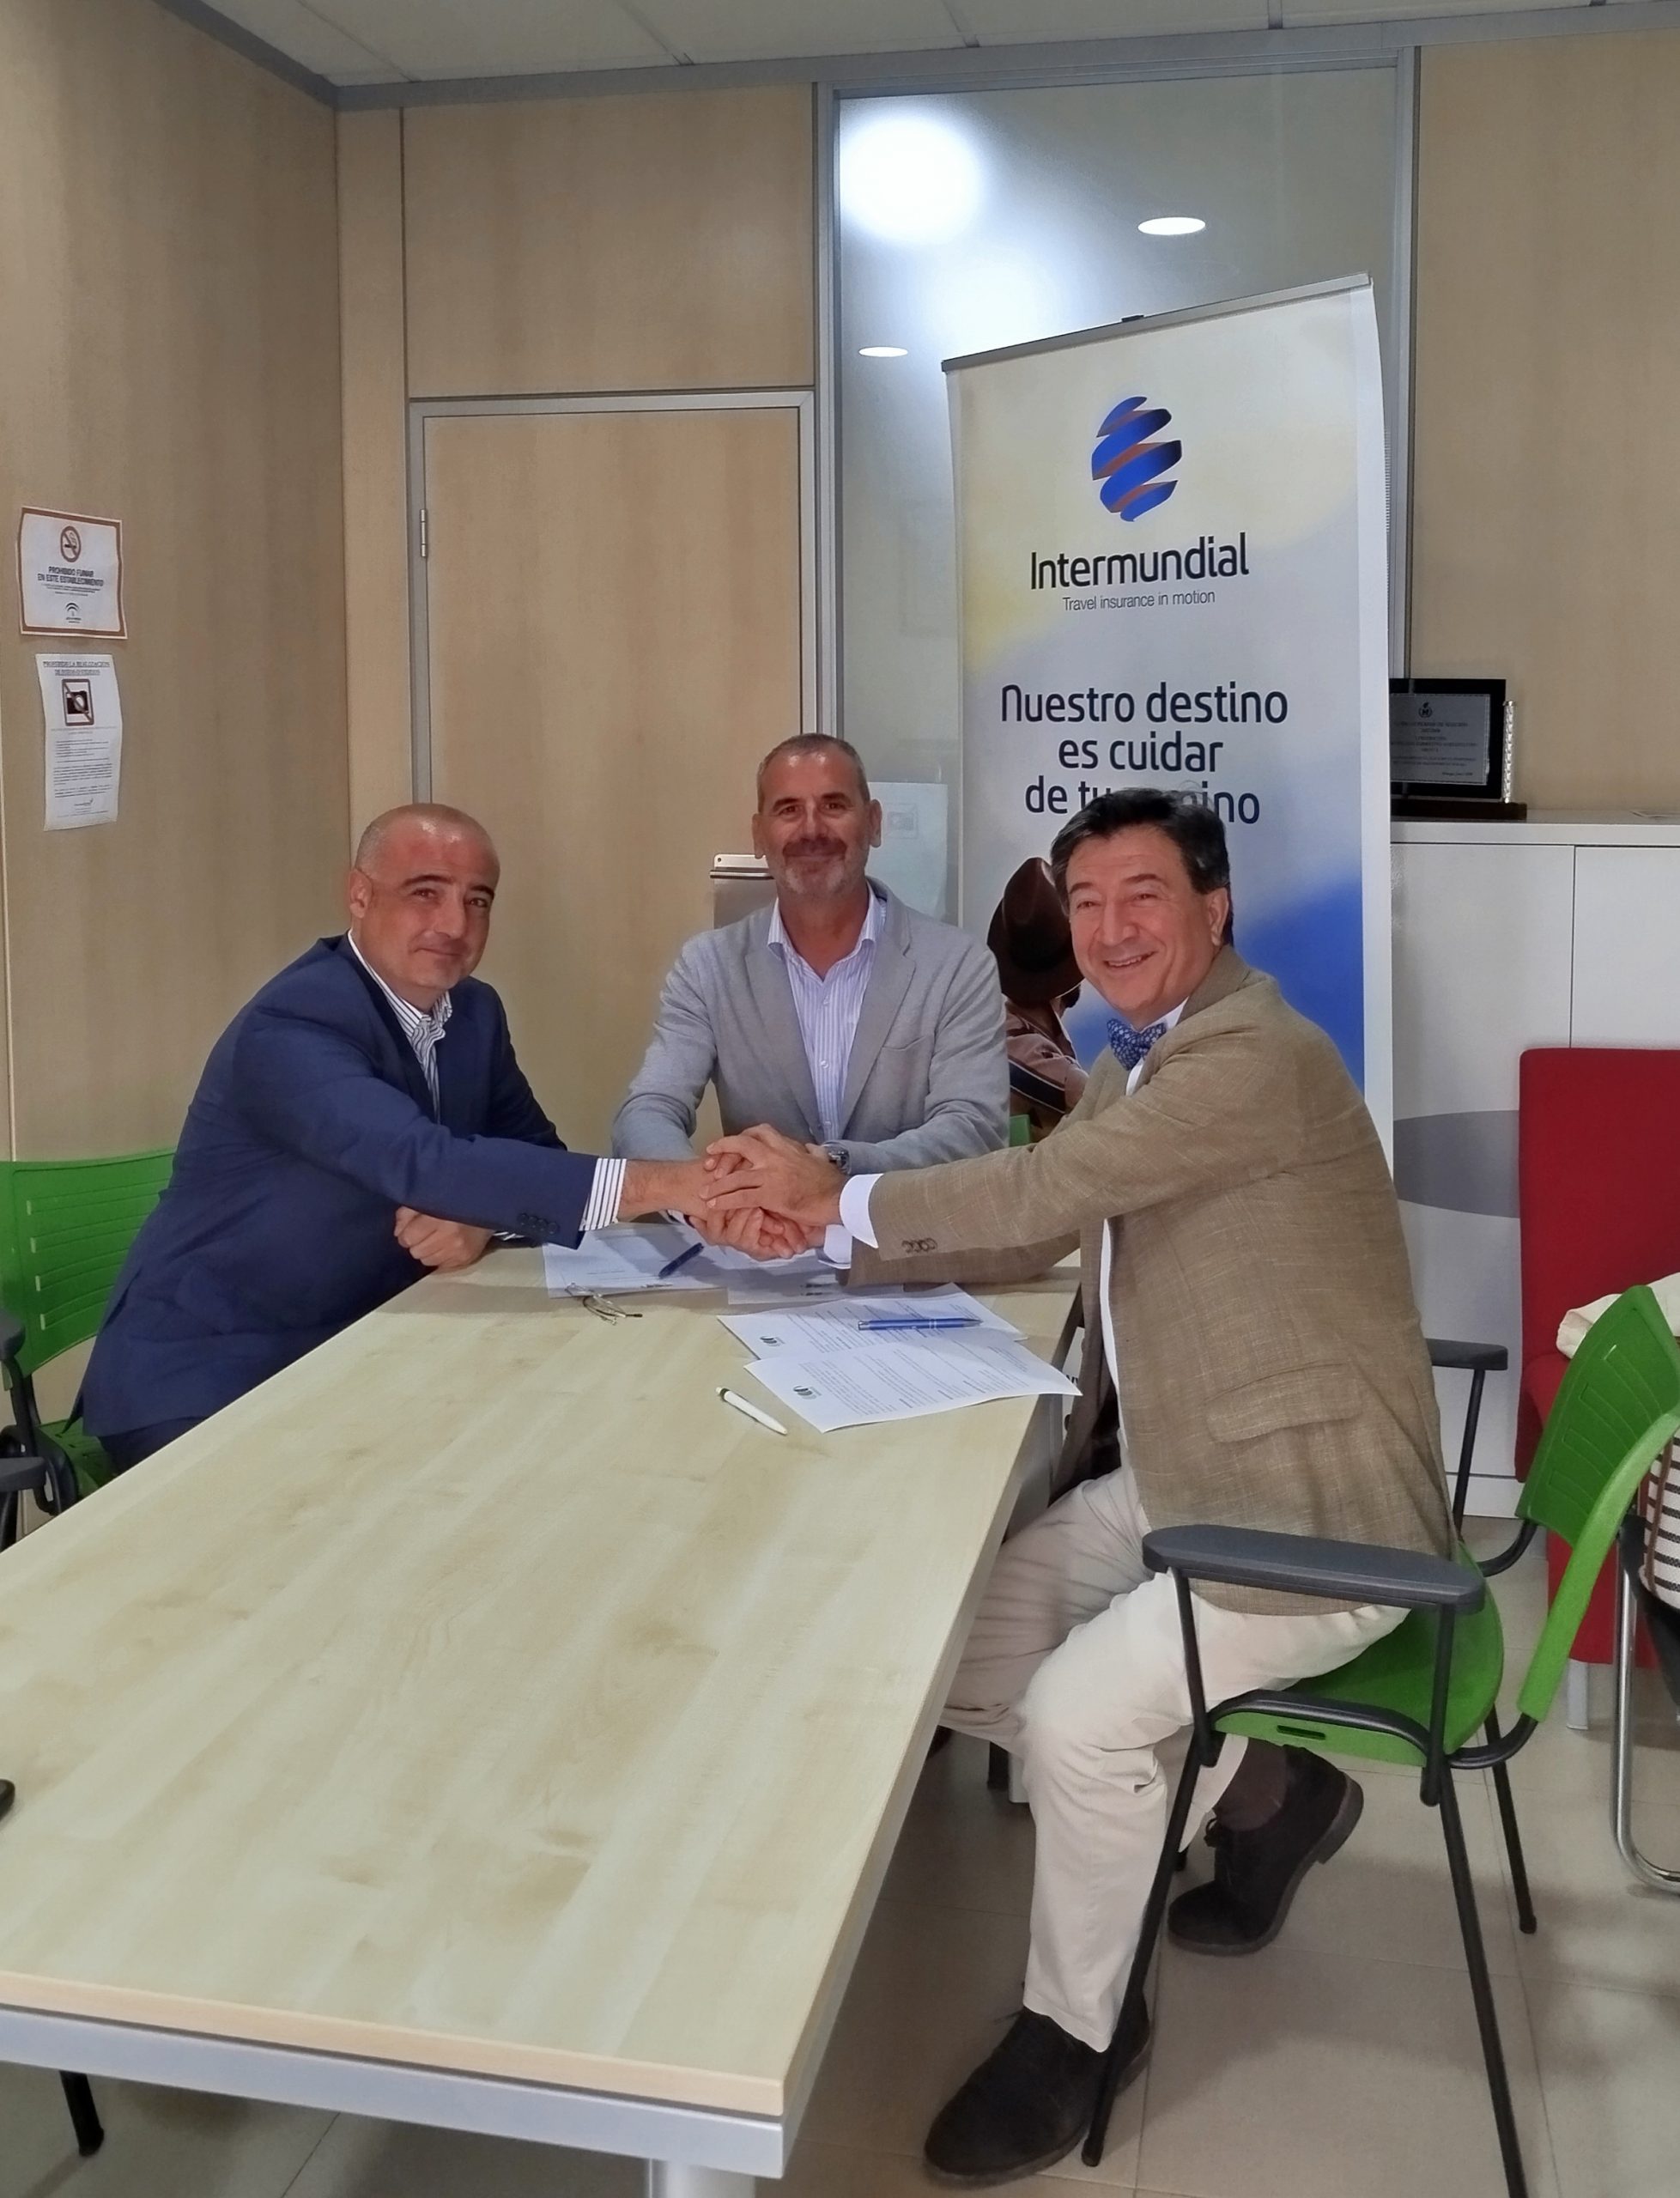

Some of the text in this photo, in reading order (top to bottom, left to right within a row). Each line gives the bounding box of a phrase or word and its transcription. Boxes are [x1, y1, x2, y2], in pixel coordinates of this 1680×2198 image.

[45, 574, 59, 583] ESTE
[1030, 531, 1250, 590] Intermundial
[1062, 590, 1216, 611] Travel insurance in motion
[1001, 681, 1288, 723] Nuestro destino
[1058, 731, 1223, 772] es cuidar
[1025, 775, 1068, 814] de
